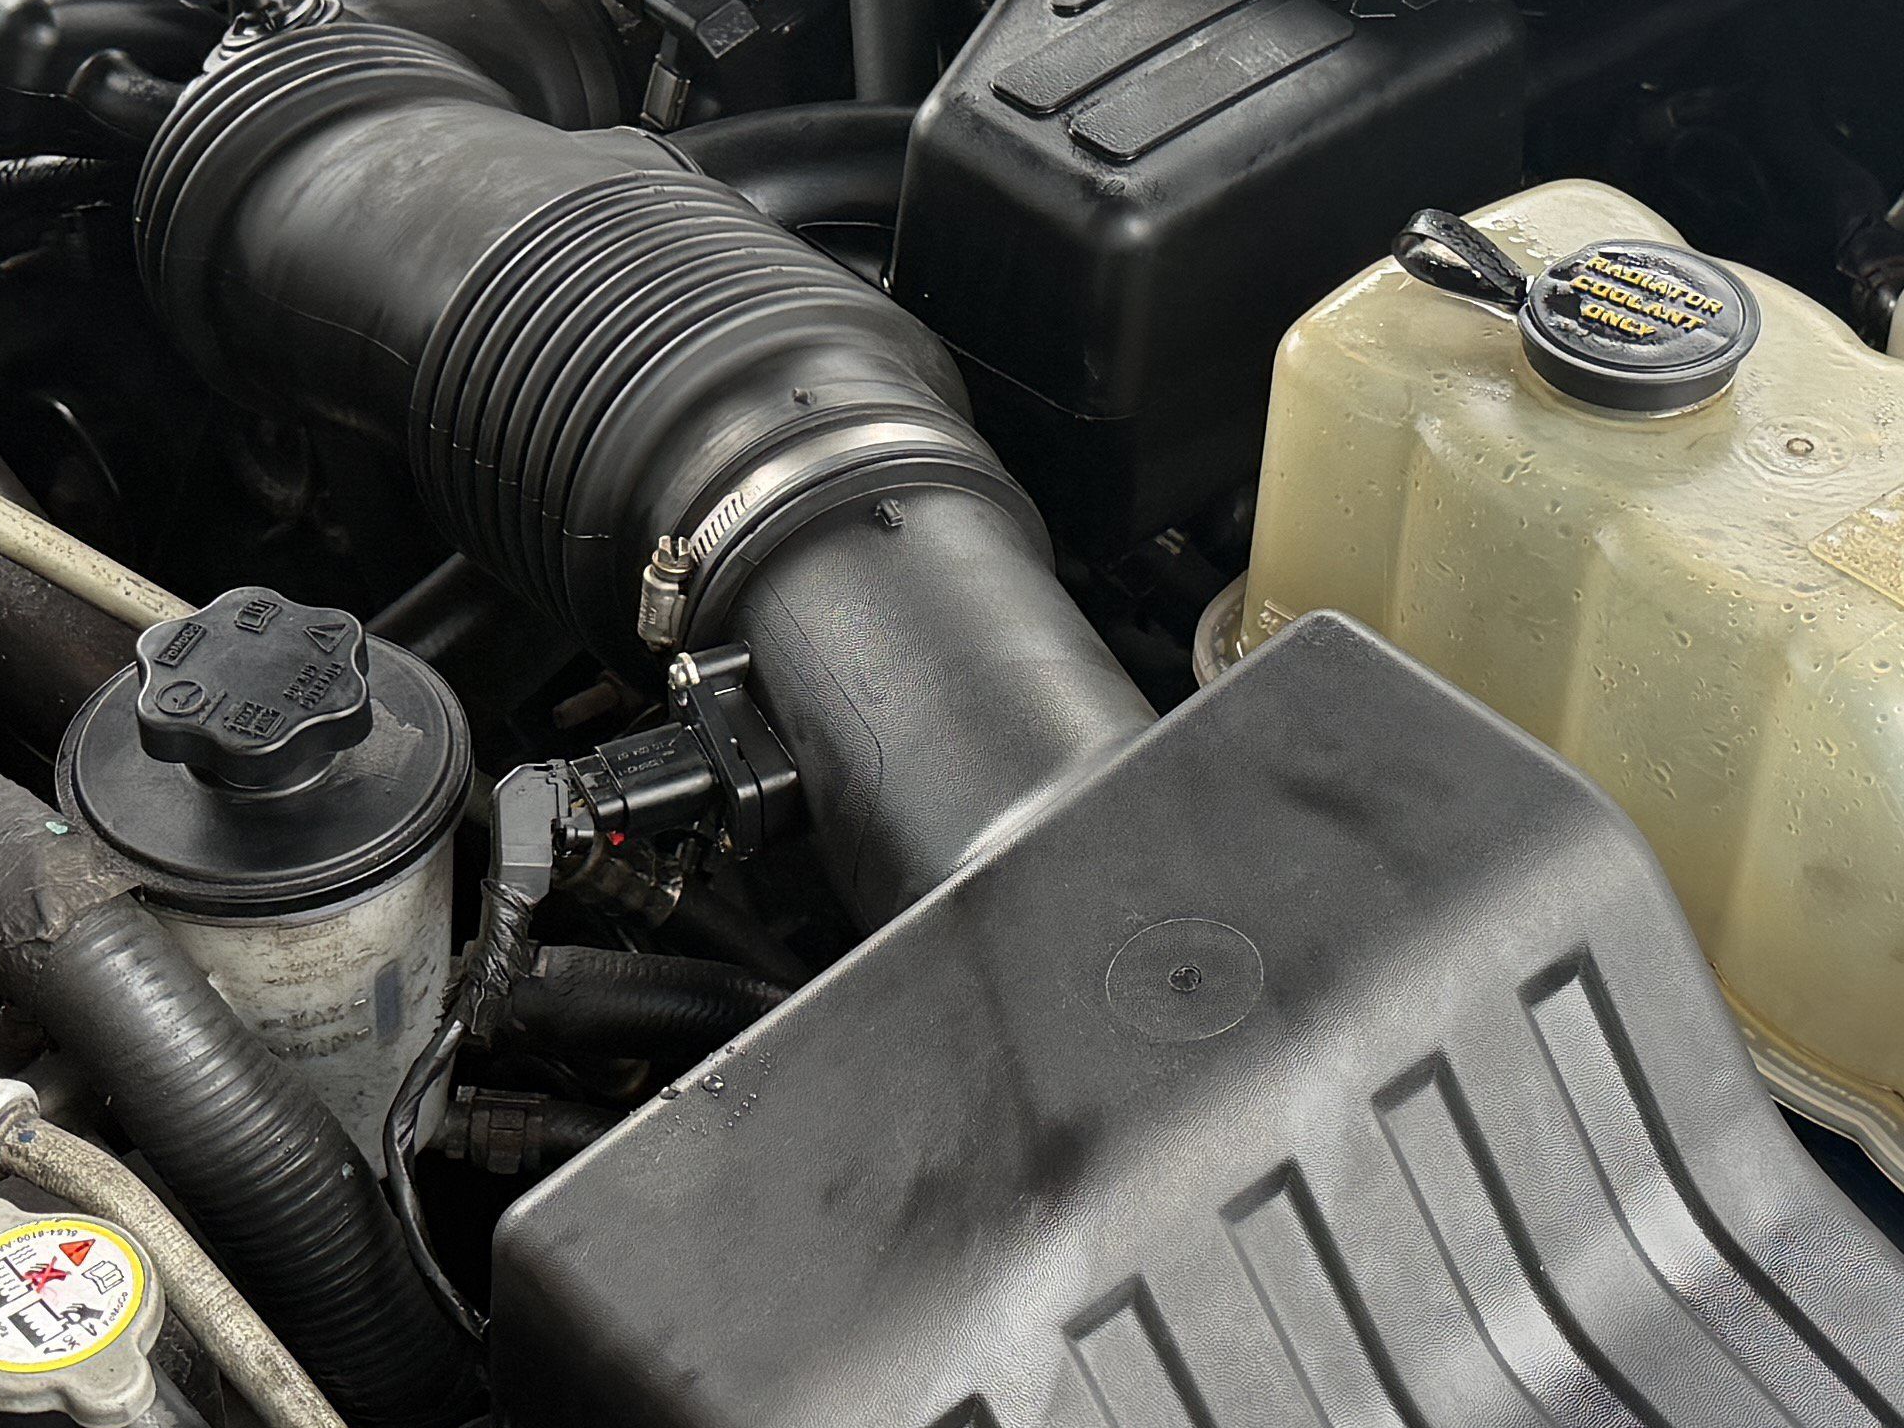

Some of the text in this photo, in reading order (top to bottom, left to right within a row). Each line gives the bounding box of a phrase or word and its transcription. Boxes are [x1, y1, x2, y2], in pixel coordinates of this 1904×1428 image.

[1569, 274, 1707, 333] COOLANT
[1584, 256, 1724, 318] RADIATOR
[1580, 303, 1658, 337] ONLY
[62, 1334, 81, 1350] OK
